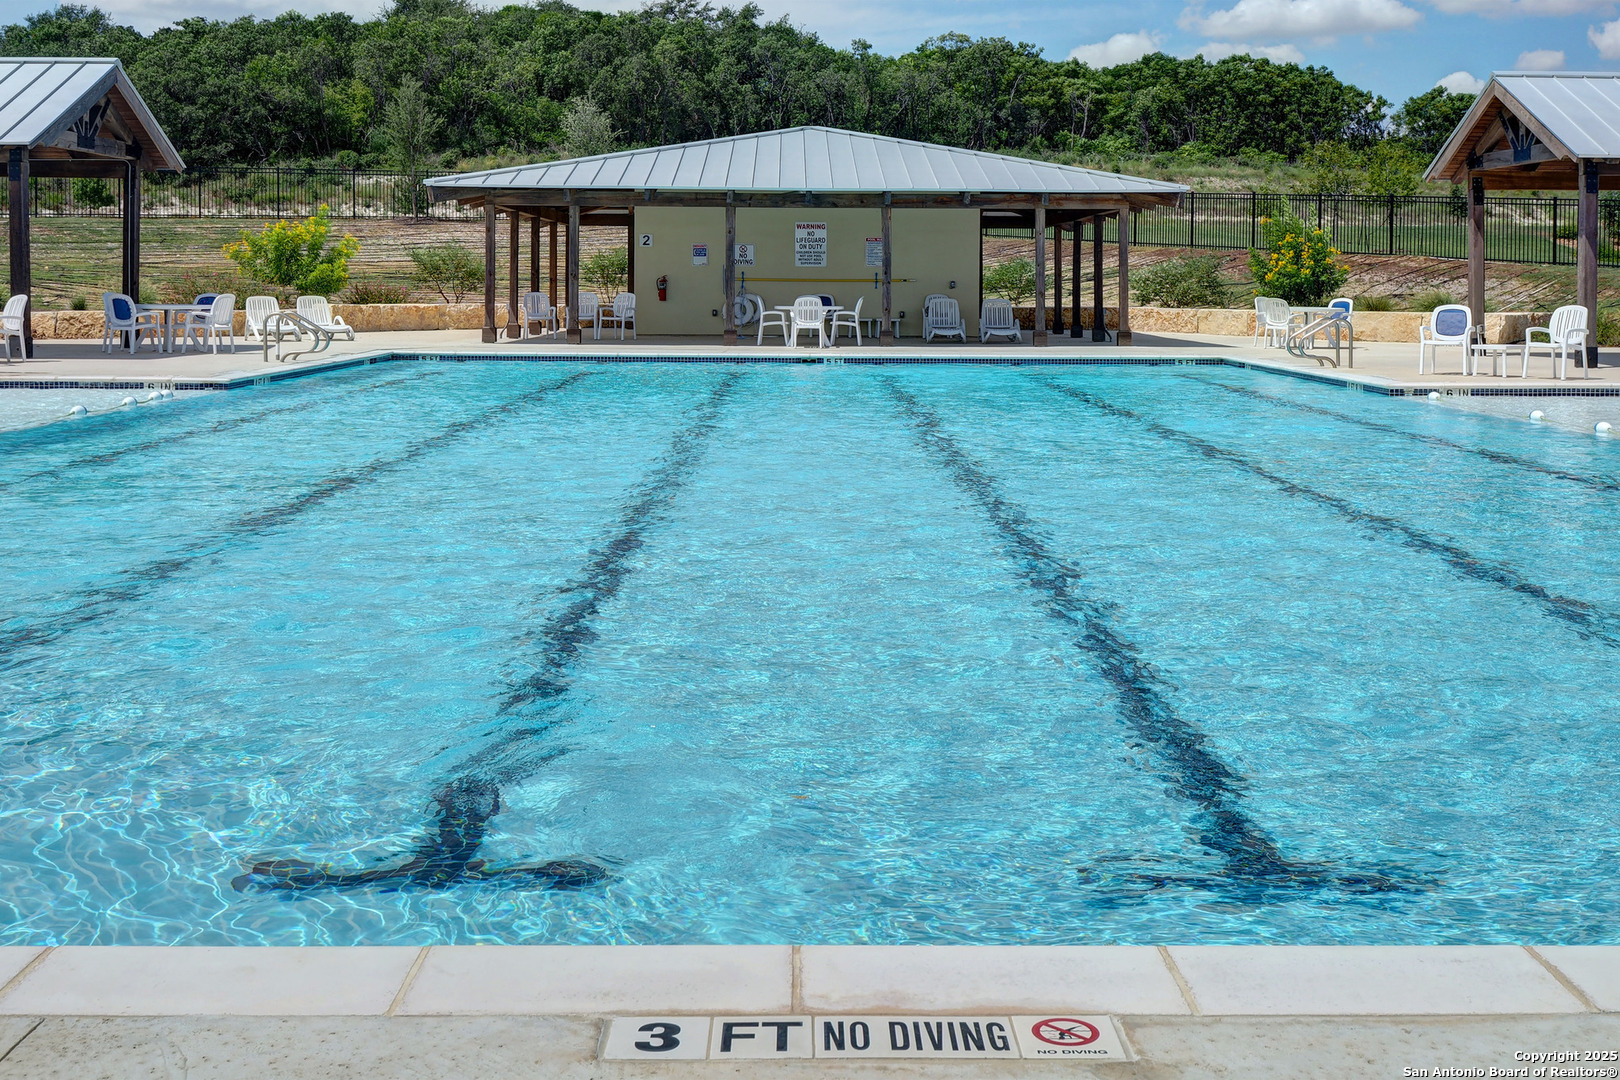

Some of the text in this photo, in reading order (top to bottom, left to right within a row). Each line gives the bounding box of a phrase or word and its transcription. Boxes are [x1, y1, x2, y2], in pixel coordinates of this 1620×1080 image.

[642, 234, 650, 246] 2
[634, 1021, 1011, 1052] 3 FT NO DIVING
